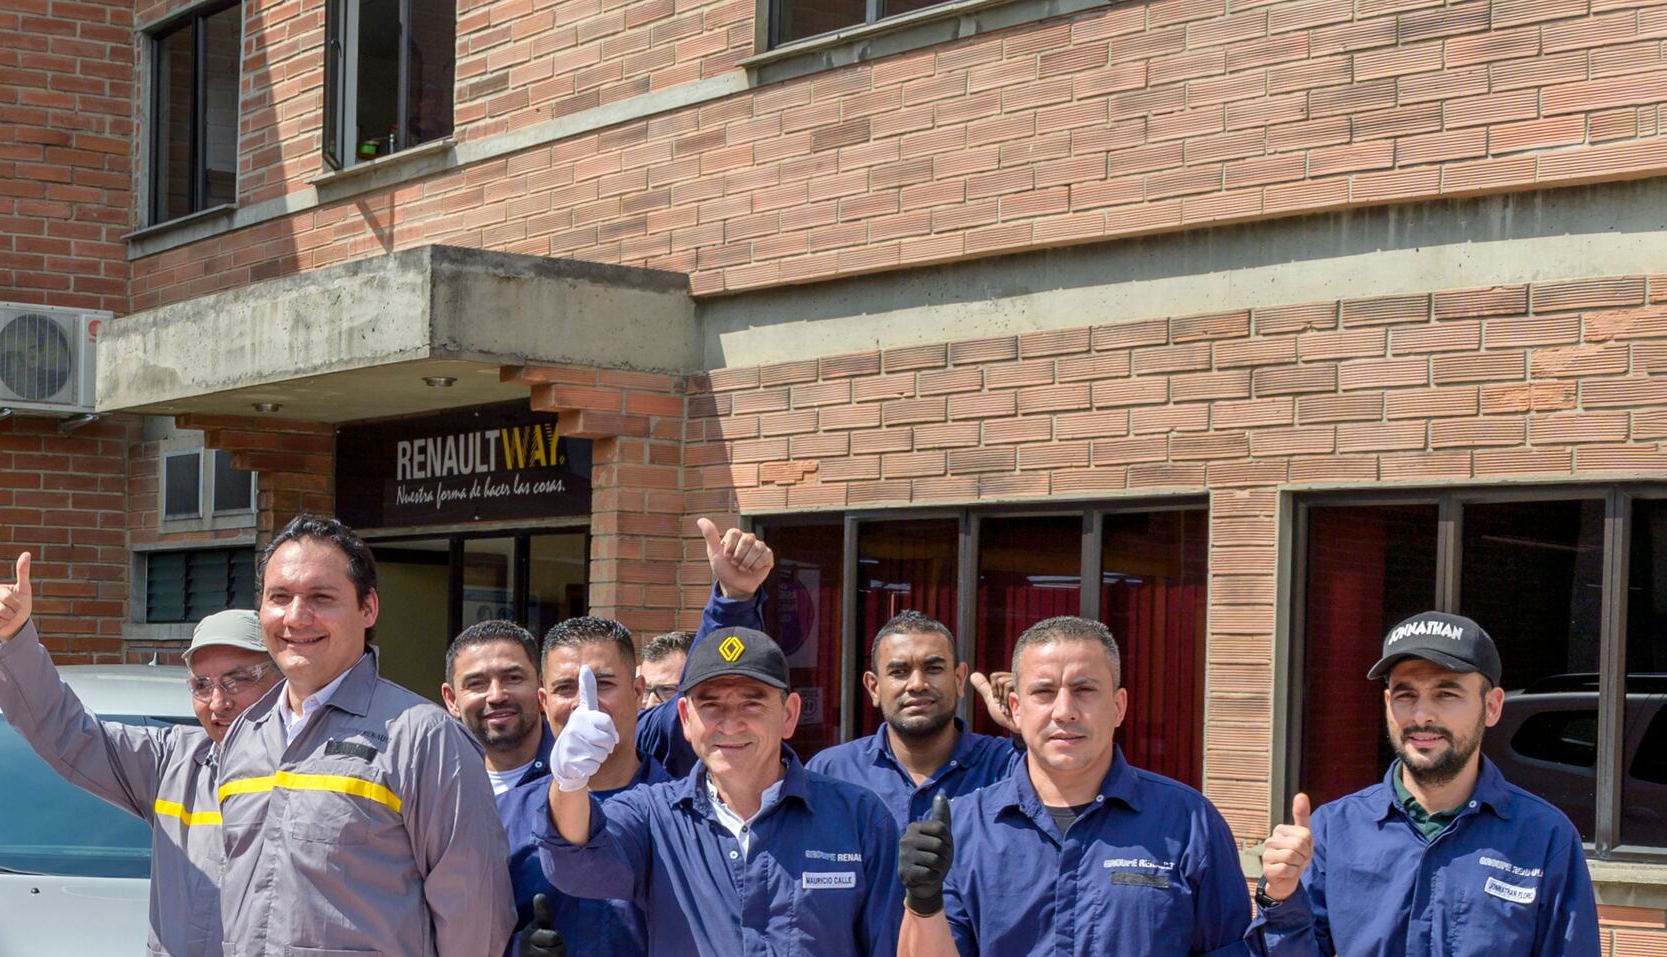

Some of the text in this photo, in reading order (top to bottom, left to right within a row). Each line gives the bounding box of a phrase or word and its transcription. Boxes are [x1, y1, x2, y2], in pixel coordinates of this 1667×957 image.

[396, 485, 434, 506] Nuestra
[437, 482, 467, 510] forma
[469, 479, 481, 498] de
[483, 476, 511, 498] hacer
[513, 473, 530, 495] las
[1388, 620, 1464, 646] JONNATHAN
[833, 876, 853, 884] CALLE
